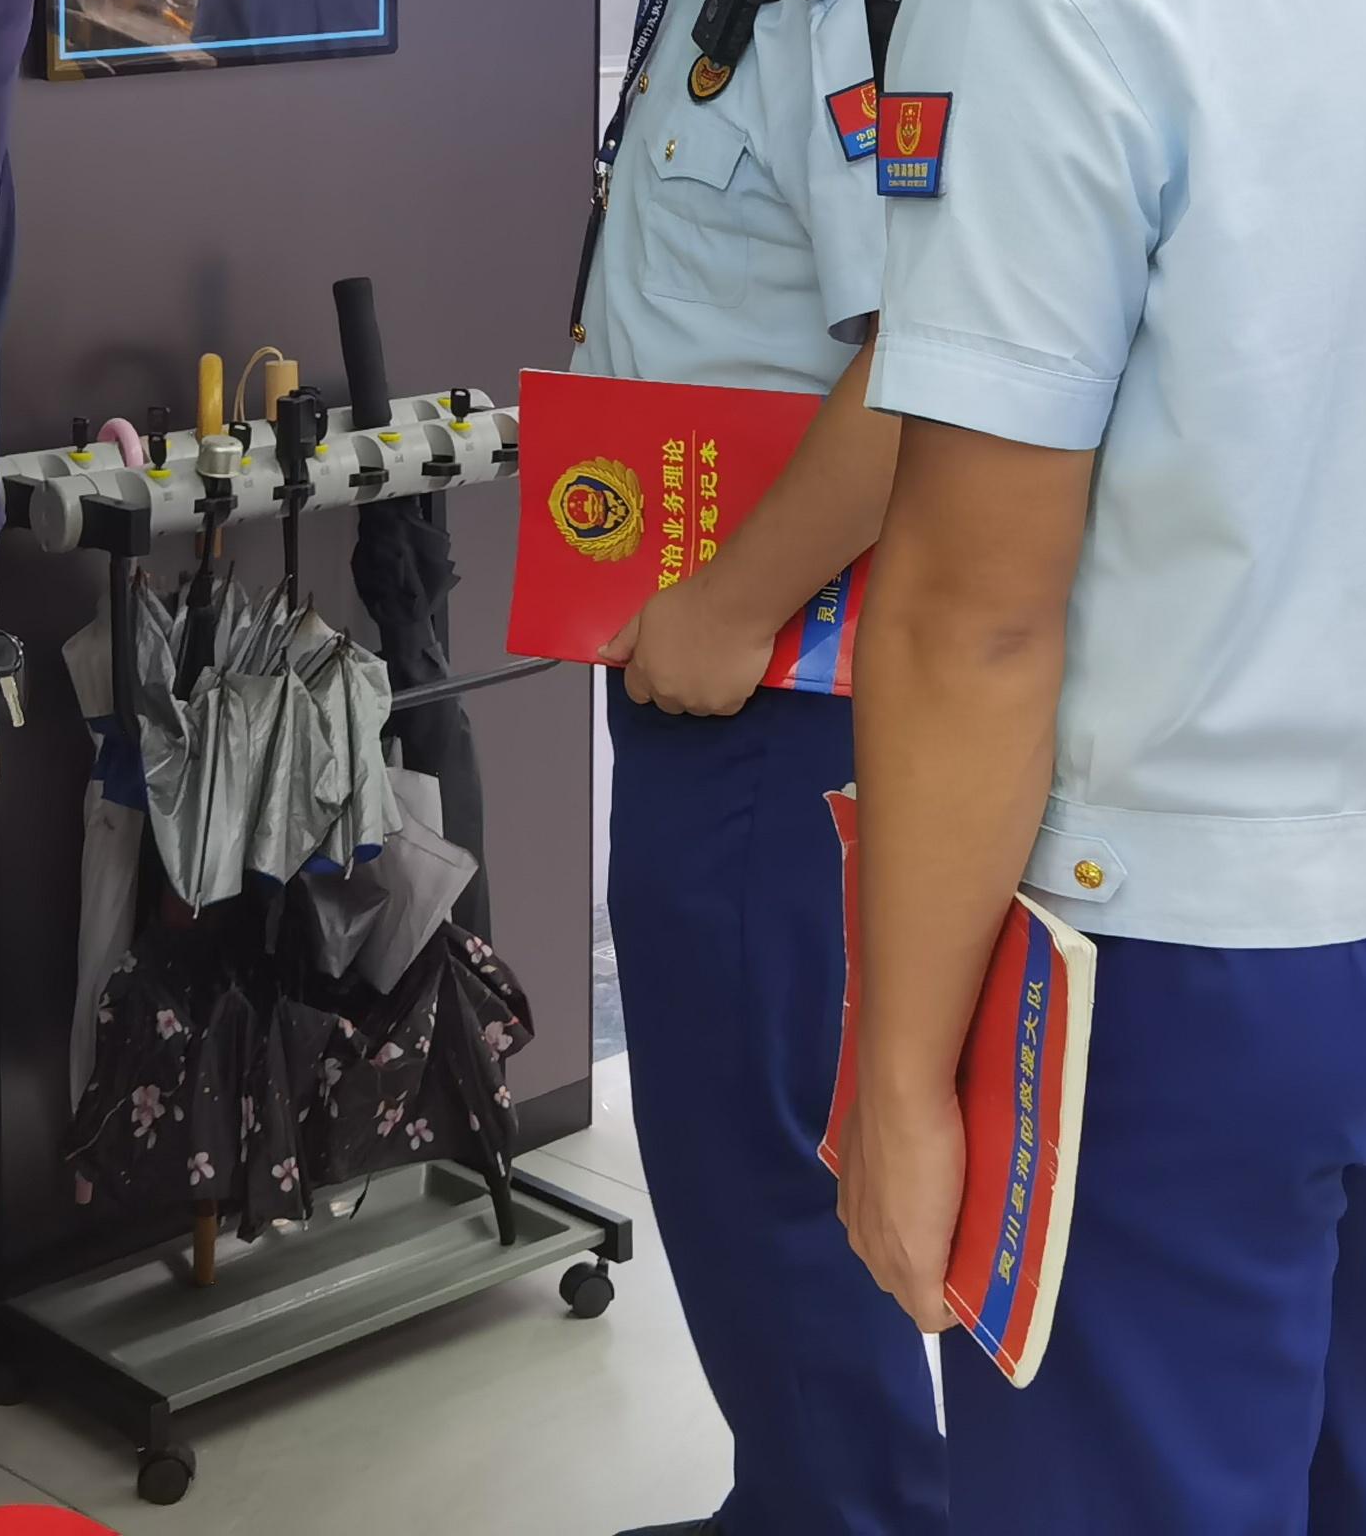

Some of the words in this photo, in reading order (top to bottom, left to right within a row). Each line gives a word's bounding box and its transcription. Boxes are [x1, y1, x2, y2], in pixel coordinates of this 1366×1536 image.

[996, 980, 1044, 1285] 灵川县消防救援大队
